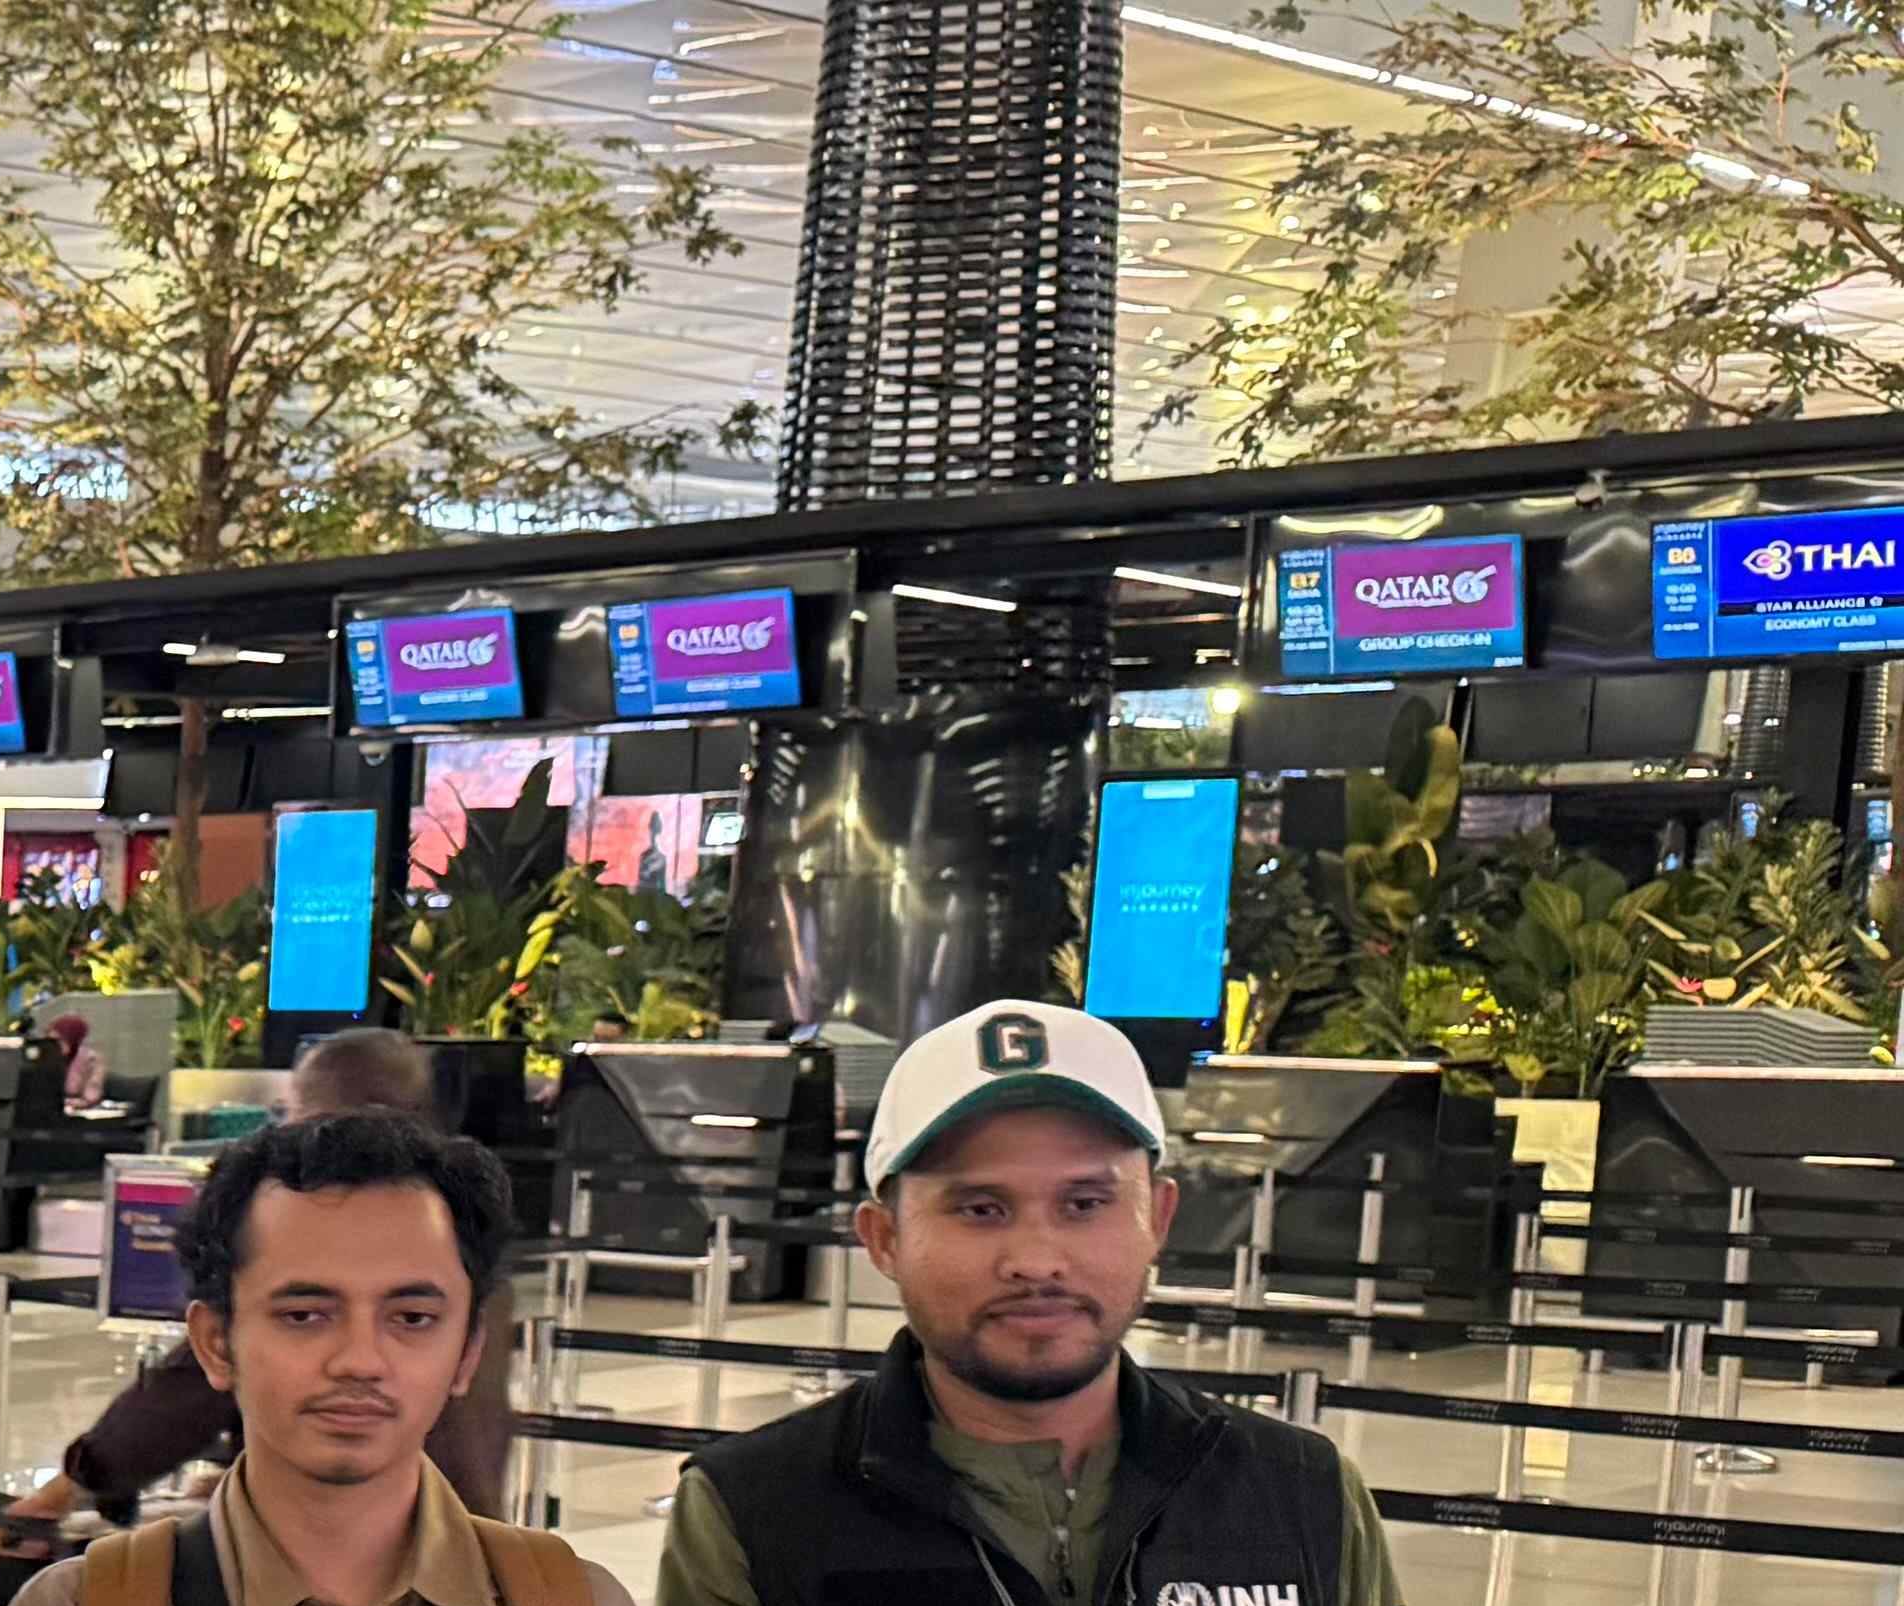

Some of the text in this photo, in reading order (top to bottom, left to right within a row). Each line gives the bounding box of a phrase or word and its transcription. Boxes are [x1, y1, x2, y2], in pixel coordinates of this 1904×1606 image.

[1794, 540, 1896, 572] THAI
[1355, 574, 1451, 606] QATAR
[1755, 598, 1866, 613] STAR ALLIANCE
[1764, 614, 1877, 632] ECONOMY CLASS
[667, 624, 740, 652] QATAR
[1359, 631, 1492, 652] GROUP CHECK-IN
[400, 640, 469, 668] QATAR
[976, 1012, 1051, 1076] G
